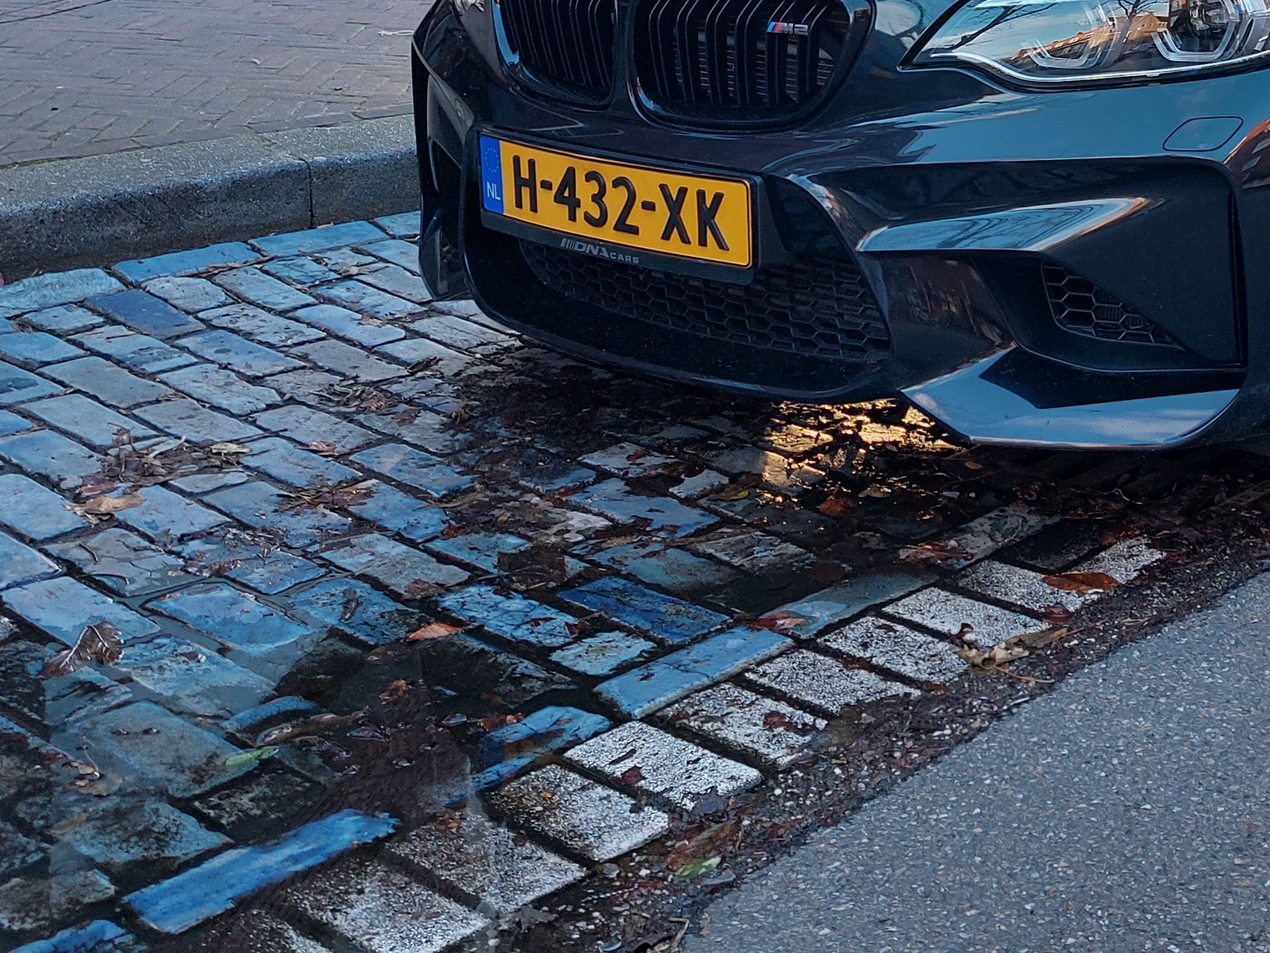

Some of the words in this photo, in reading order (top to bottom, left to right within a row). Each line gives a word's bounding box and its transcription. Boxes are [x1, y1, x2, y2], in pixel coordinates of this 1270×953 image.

[486, 181, 501, 200] NL
[512, 154, 730, 251] H-432-XK
[609, 252, 640, 264] CARS
